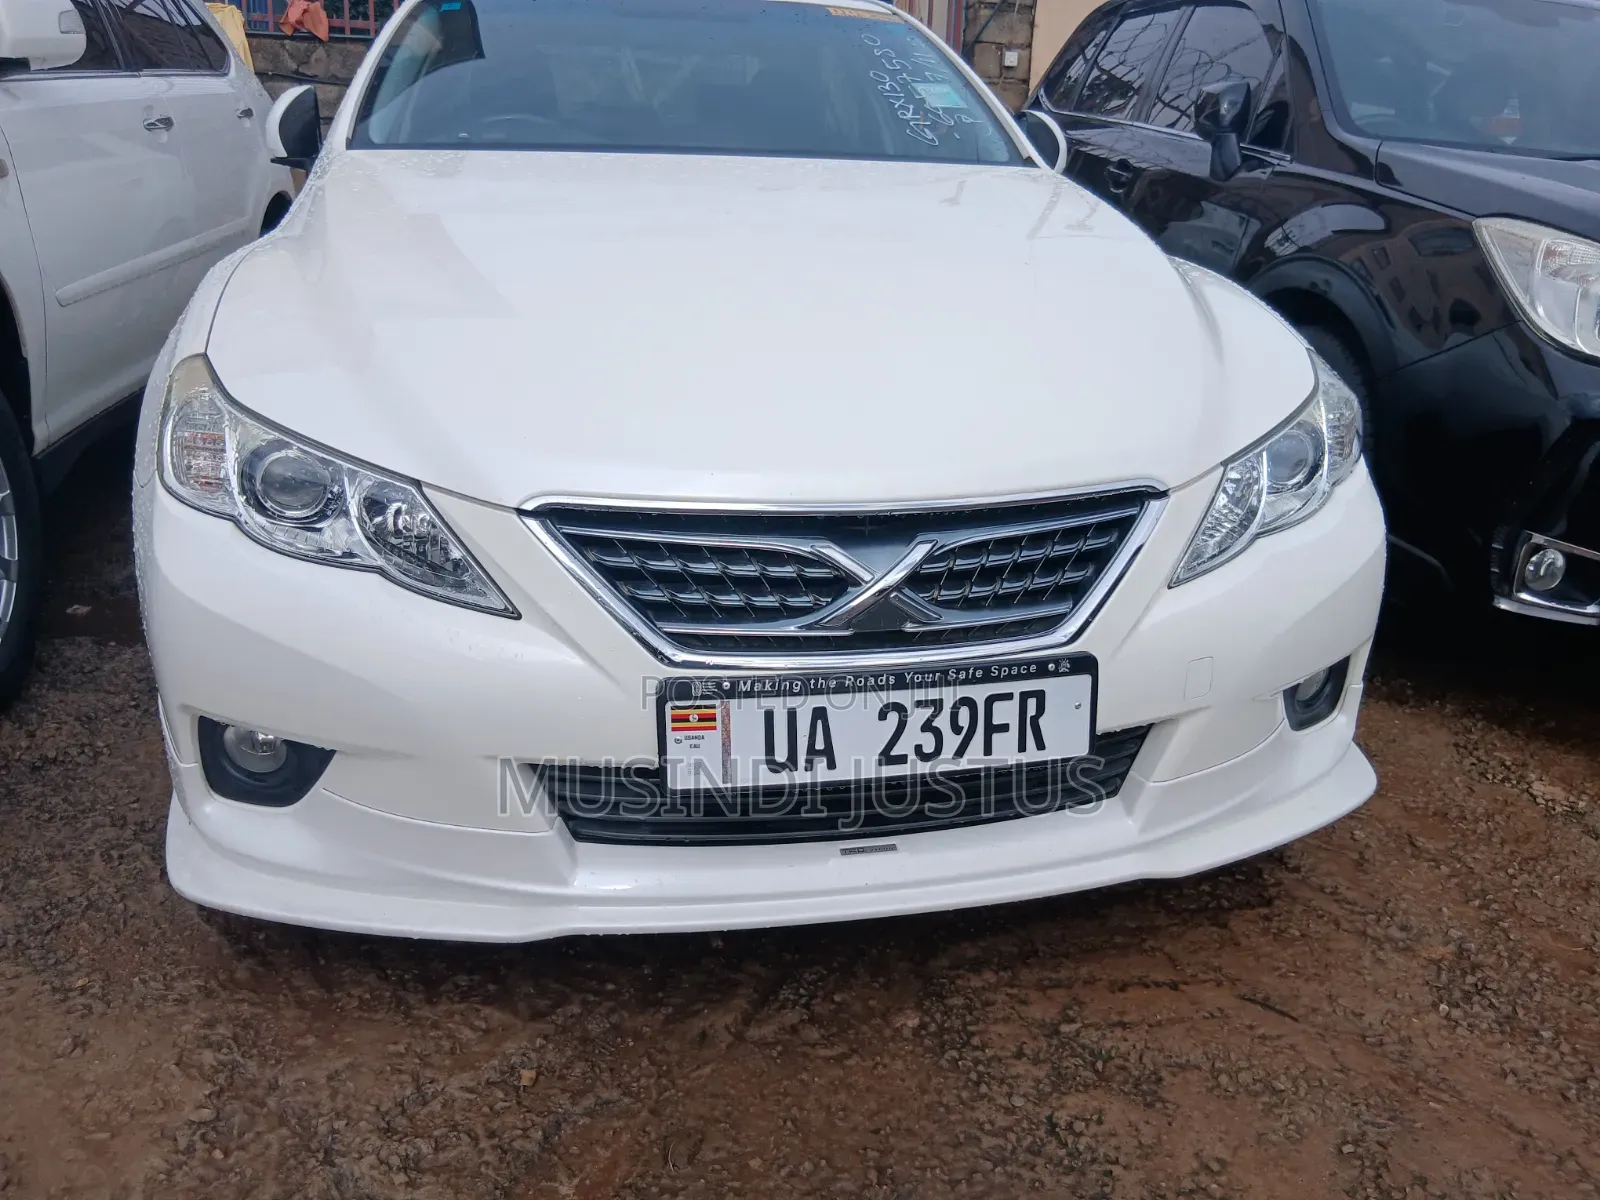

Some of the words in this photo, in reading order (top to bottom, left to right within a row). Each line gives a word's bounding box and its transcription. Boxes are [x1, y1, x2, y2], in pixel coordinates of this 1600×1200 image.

[869, 70, 939, 146] GRX130
[738, 679, 801, 692] Making
[810, 677, 837, 689] the
[845, 674, 896, 687] Roads
[904, 671, 941, 683] Your
[948, 667, 983, 680] Safe
[990, 663, 1037, 678] Space
[763, 706, 837, 774] UA
[877, 689, 1046, 767] 239FR
